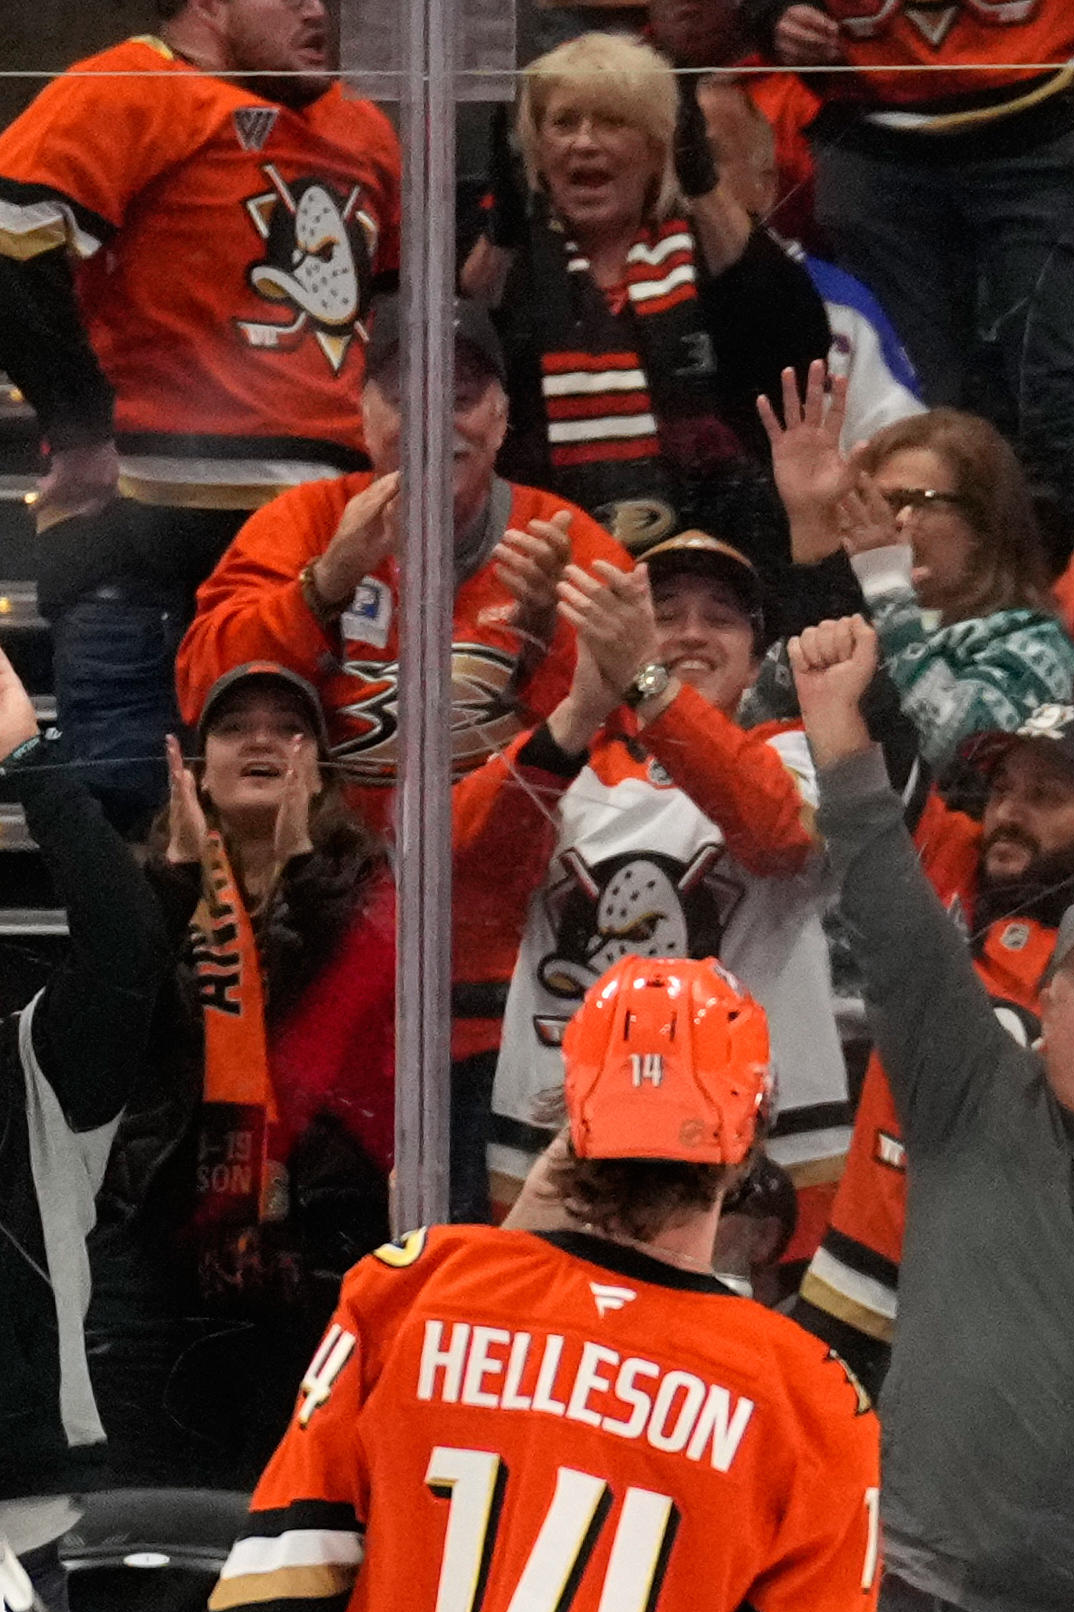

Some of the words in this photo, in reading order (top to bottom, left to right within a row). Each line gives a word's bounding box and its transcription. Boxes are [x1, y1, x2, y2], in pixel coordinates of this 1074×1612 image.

[629, 1053, 663, 1087] 14
[196, 1164, 252, 1194] SON
[417, 1319, 755, 1473] HELLESON
